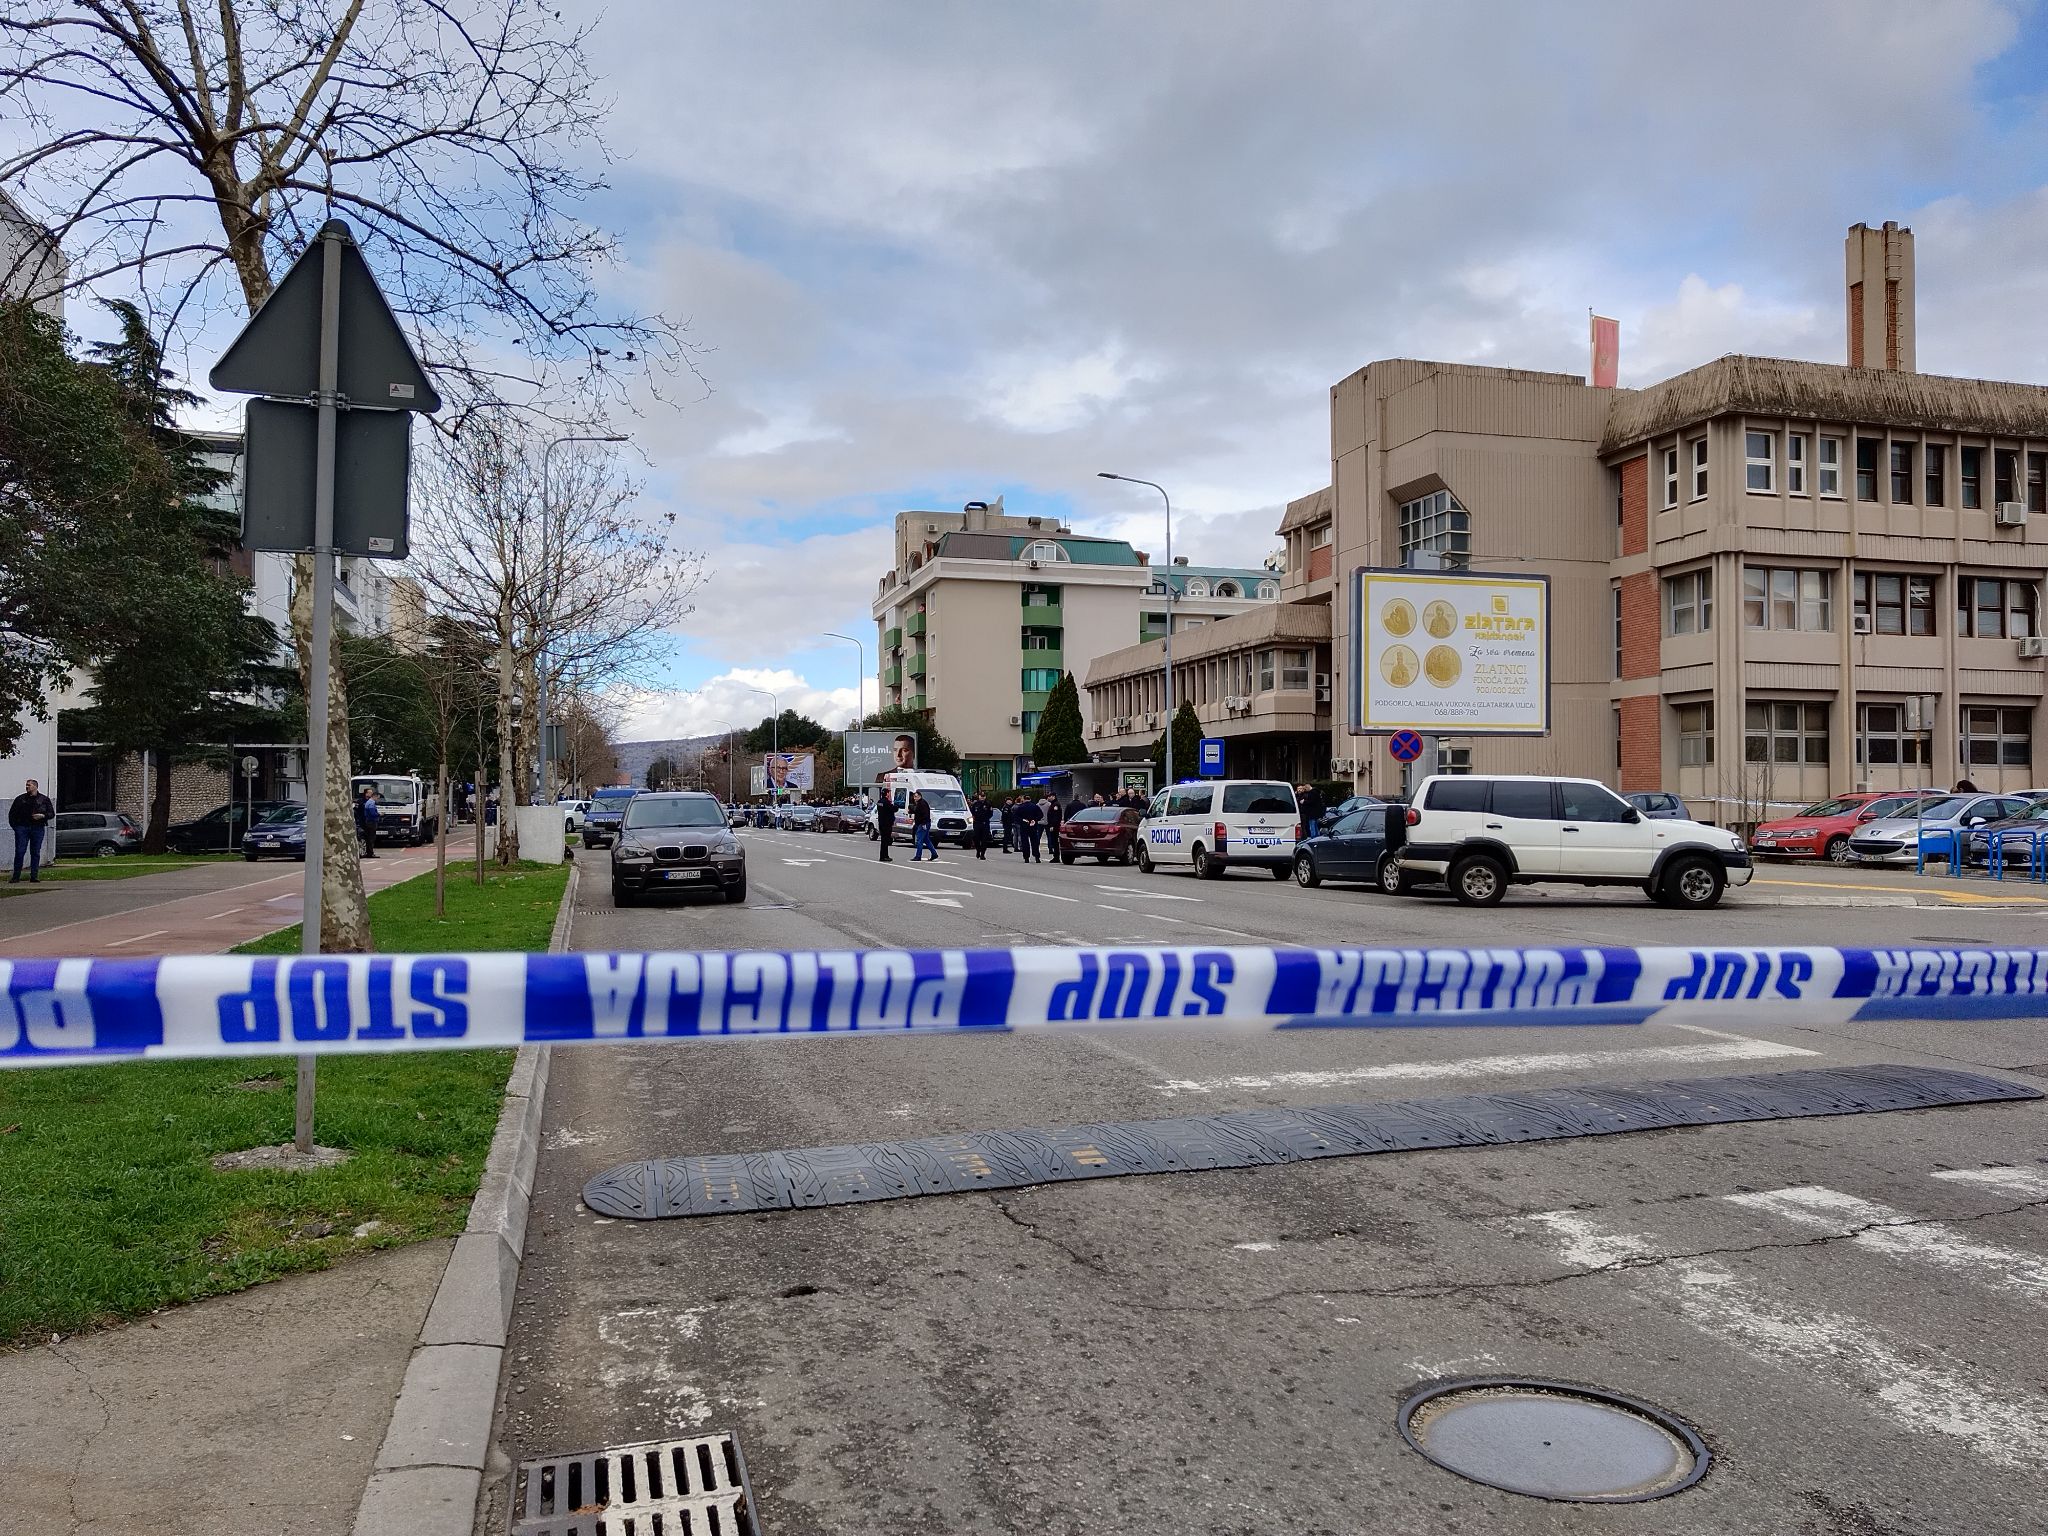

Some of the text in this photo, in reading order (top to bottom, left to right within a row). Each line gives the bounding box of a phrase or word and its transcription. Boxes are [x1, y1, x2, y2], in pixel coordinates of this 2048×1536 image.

[1469, 645, 1483, 660] Za
[1475, 664, 1527, 674] ZLATNICI
[1504, 677, 1529, 685] ZLATA
[1151, 828, 1182, 846] POLICIJA
[1242, 837, 1283, 846] POLICIJA
[1047, 952, 1235, 1022] STOP
[1314, 950, 1606, 1017] POLICIJA
[218, 957, 470, 1044] STOP
[586, 952, 966, 1036] POLICIJA
